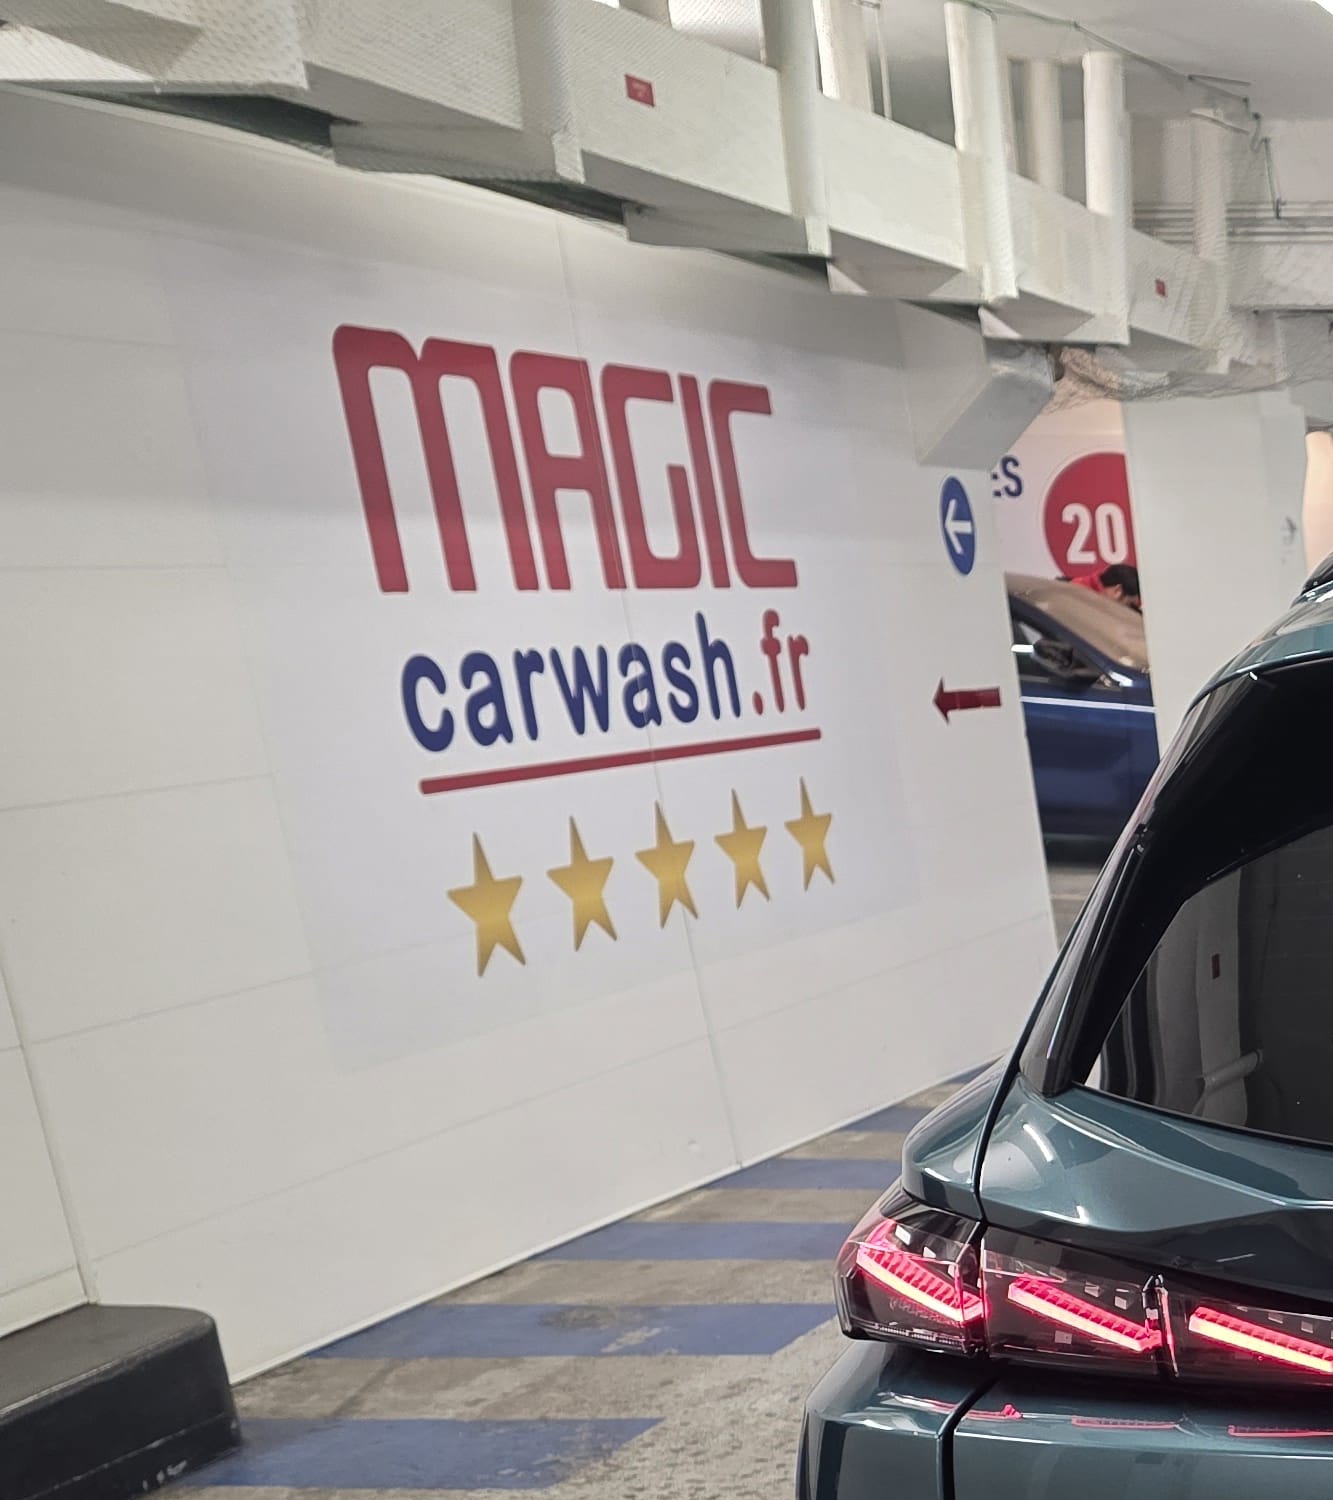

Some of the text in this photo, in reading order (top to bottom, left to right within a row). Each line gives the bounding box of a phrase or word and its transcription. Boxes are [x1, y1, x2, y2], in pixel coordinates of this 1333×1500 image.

[333, 323, 798, 595] MAGIC
[991, 454, 1023, 498] S
[1062, 503, 1128, 564] 20
[401, 608, 809, 753] carwash.fr
